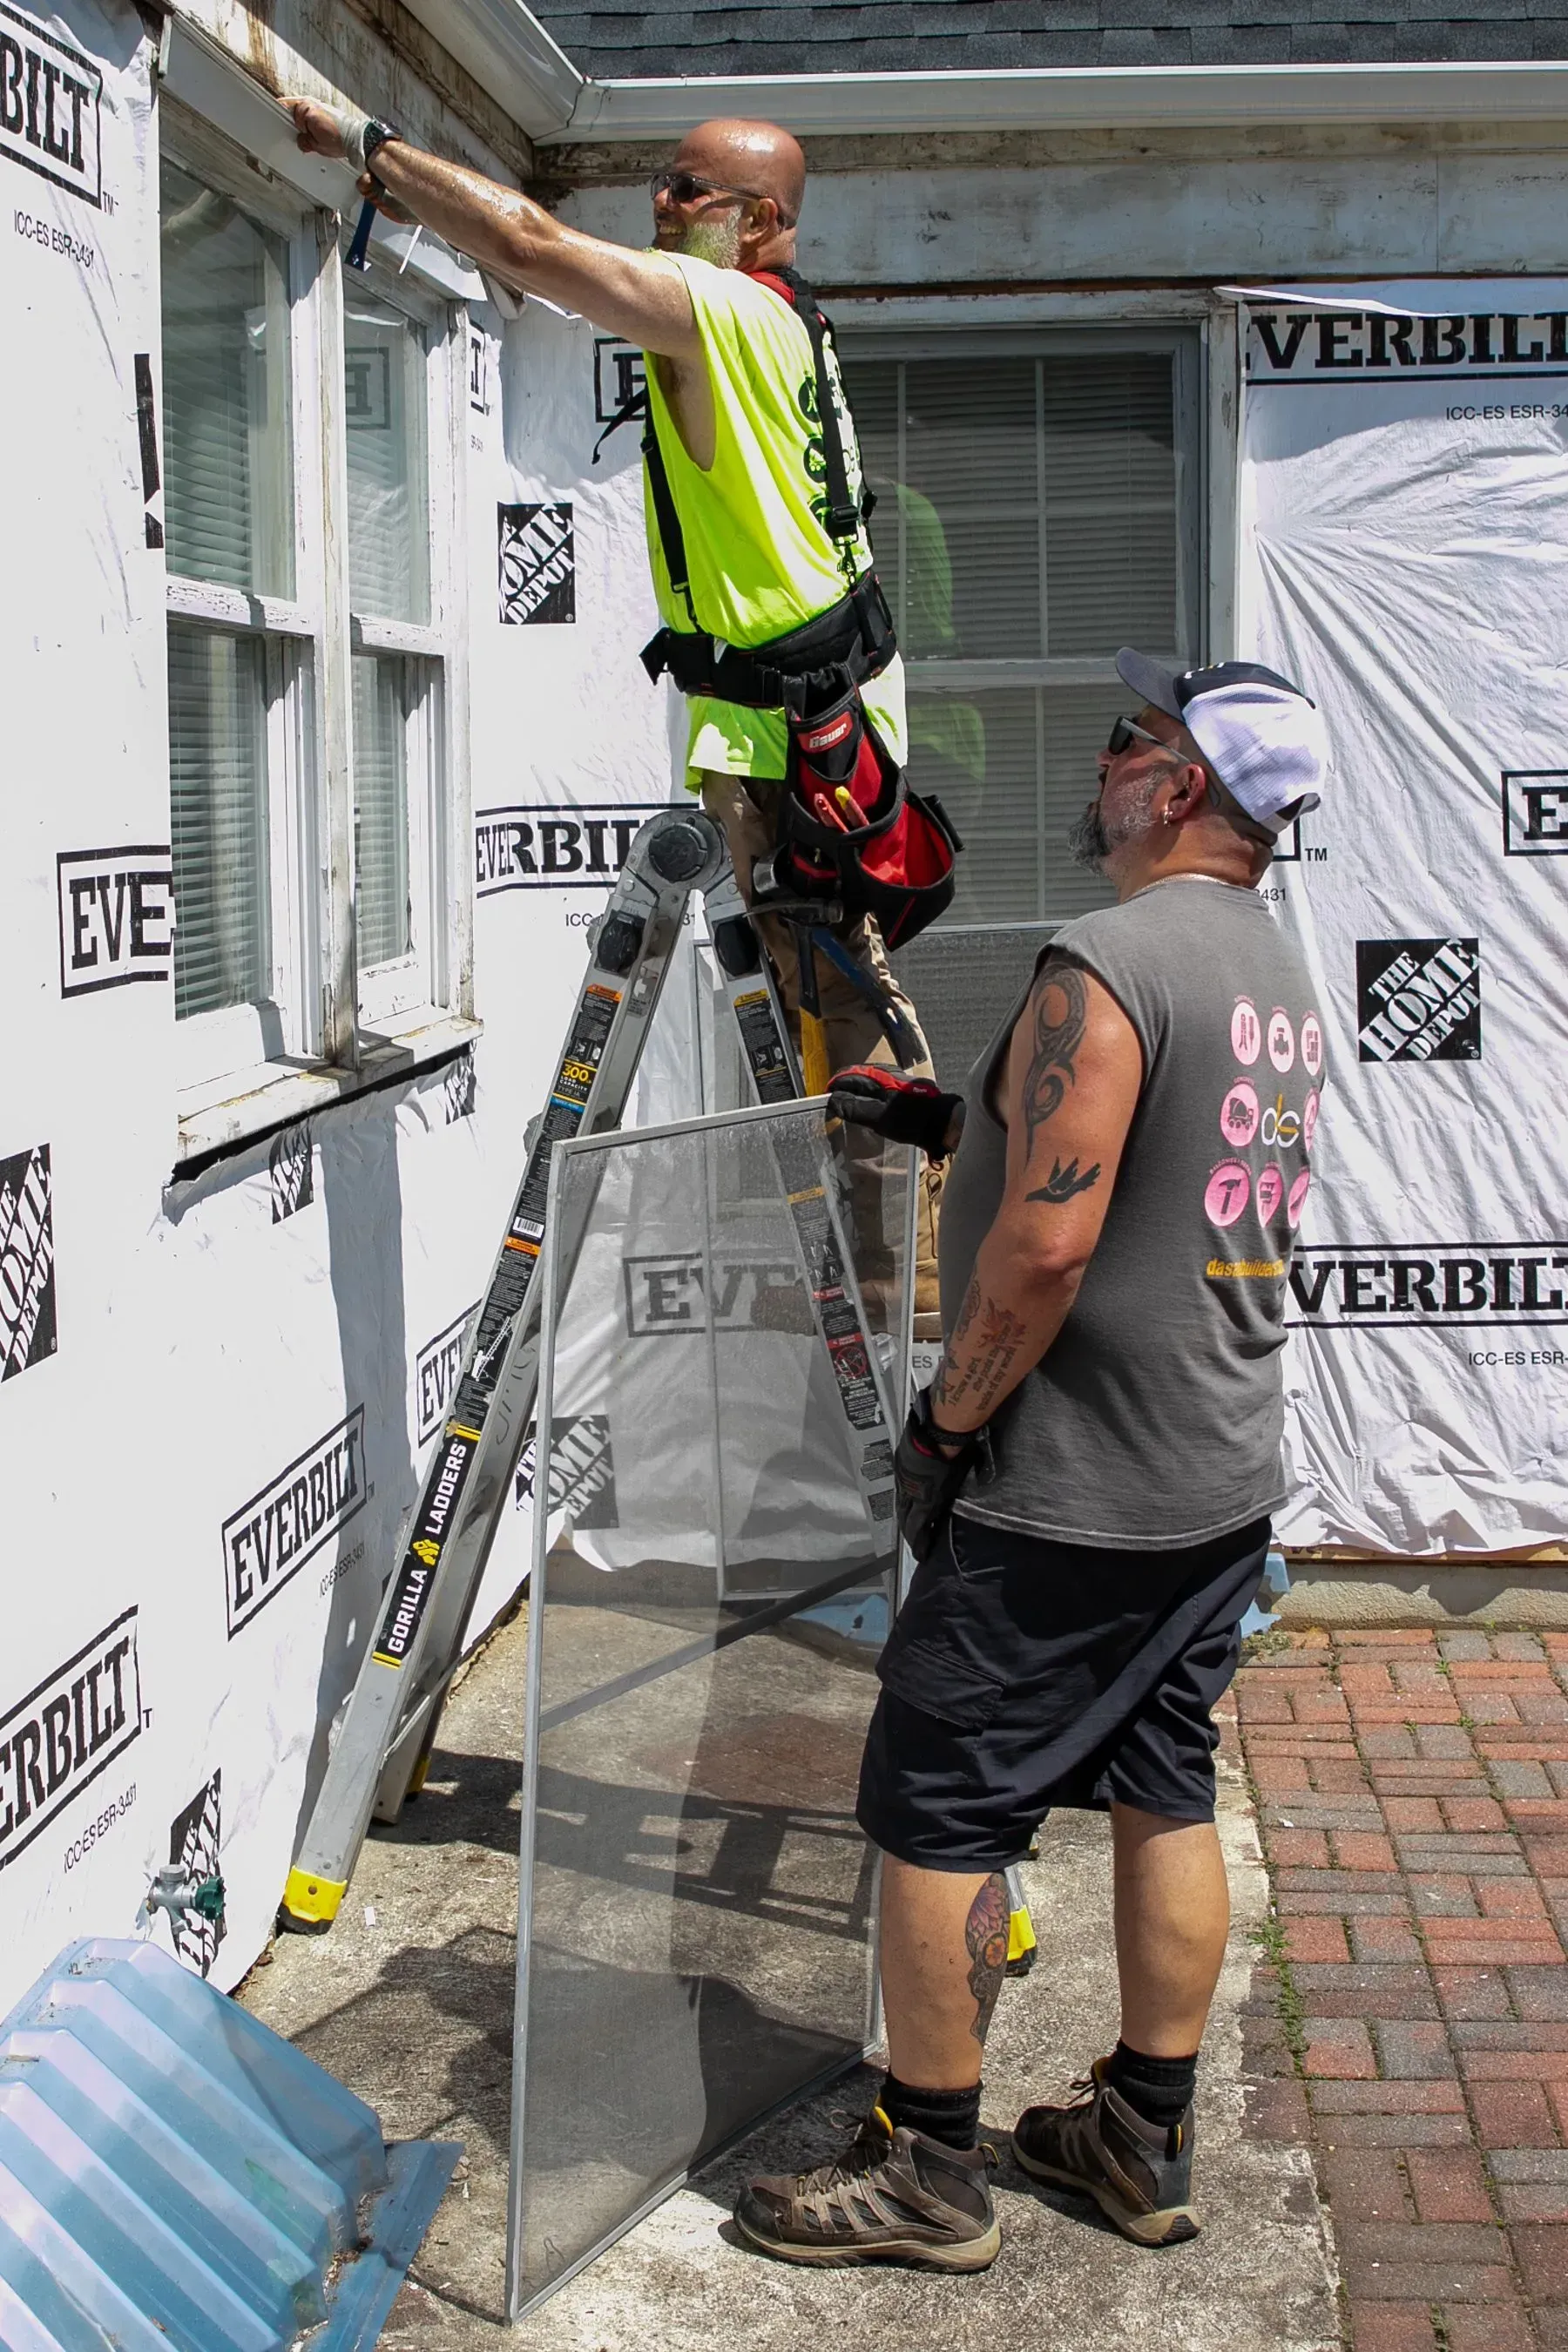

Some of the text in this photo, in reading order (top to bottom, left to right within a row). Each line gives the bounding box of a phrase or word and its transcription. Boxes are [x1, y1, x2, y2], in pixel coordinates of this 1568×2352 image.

[1246, 312, 1568, 369] VERBILT
[1446, 406, 1504, 420] ICC-ES
[507, 547, 575, 625] DEPOT
[1305, 848, 1328, 861] TM
[1359, 938, 1480, 1061] HOME
[1369, 950, 1420, 1002] THE
[1406, 982, 1481, 1061] DEPOT
[562, 1064, 589, 1082] 300
[1469, 1352, 1525, 1366] ICC-ES
[232, 1428, 358, 1612] EVERBILT
[388, 1443, 467, 1652] GORILLA LADDERS
[97, 1782, 137, 1838] ESR-3431
